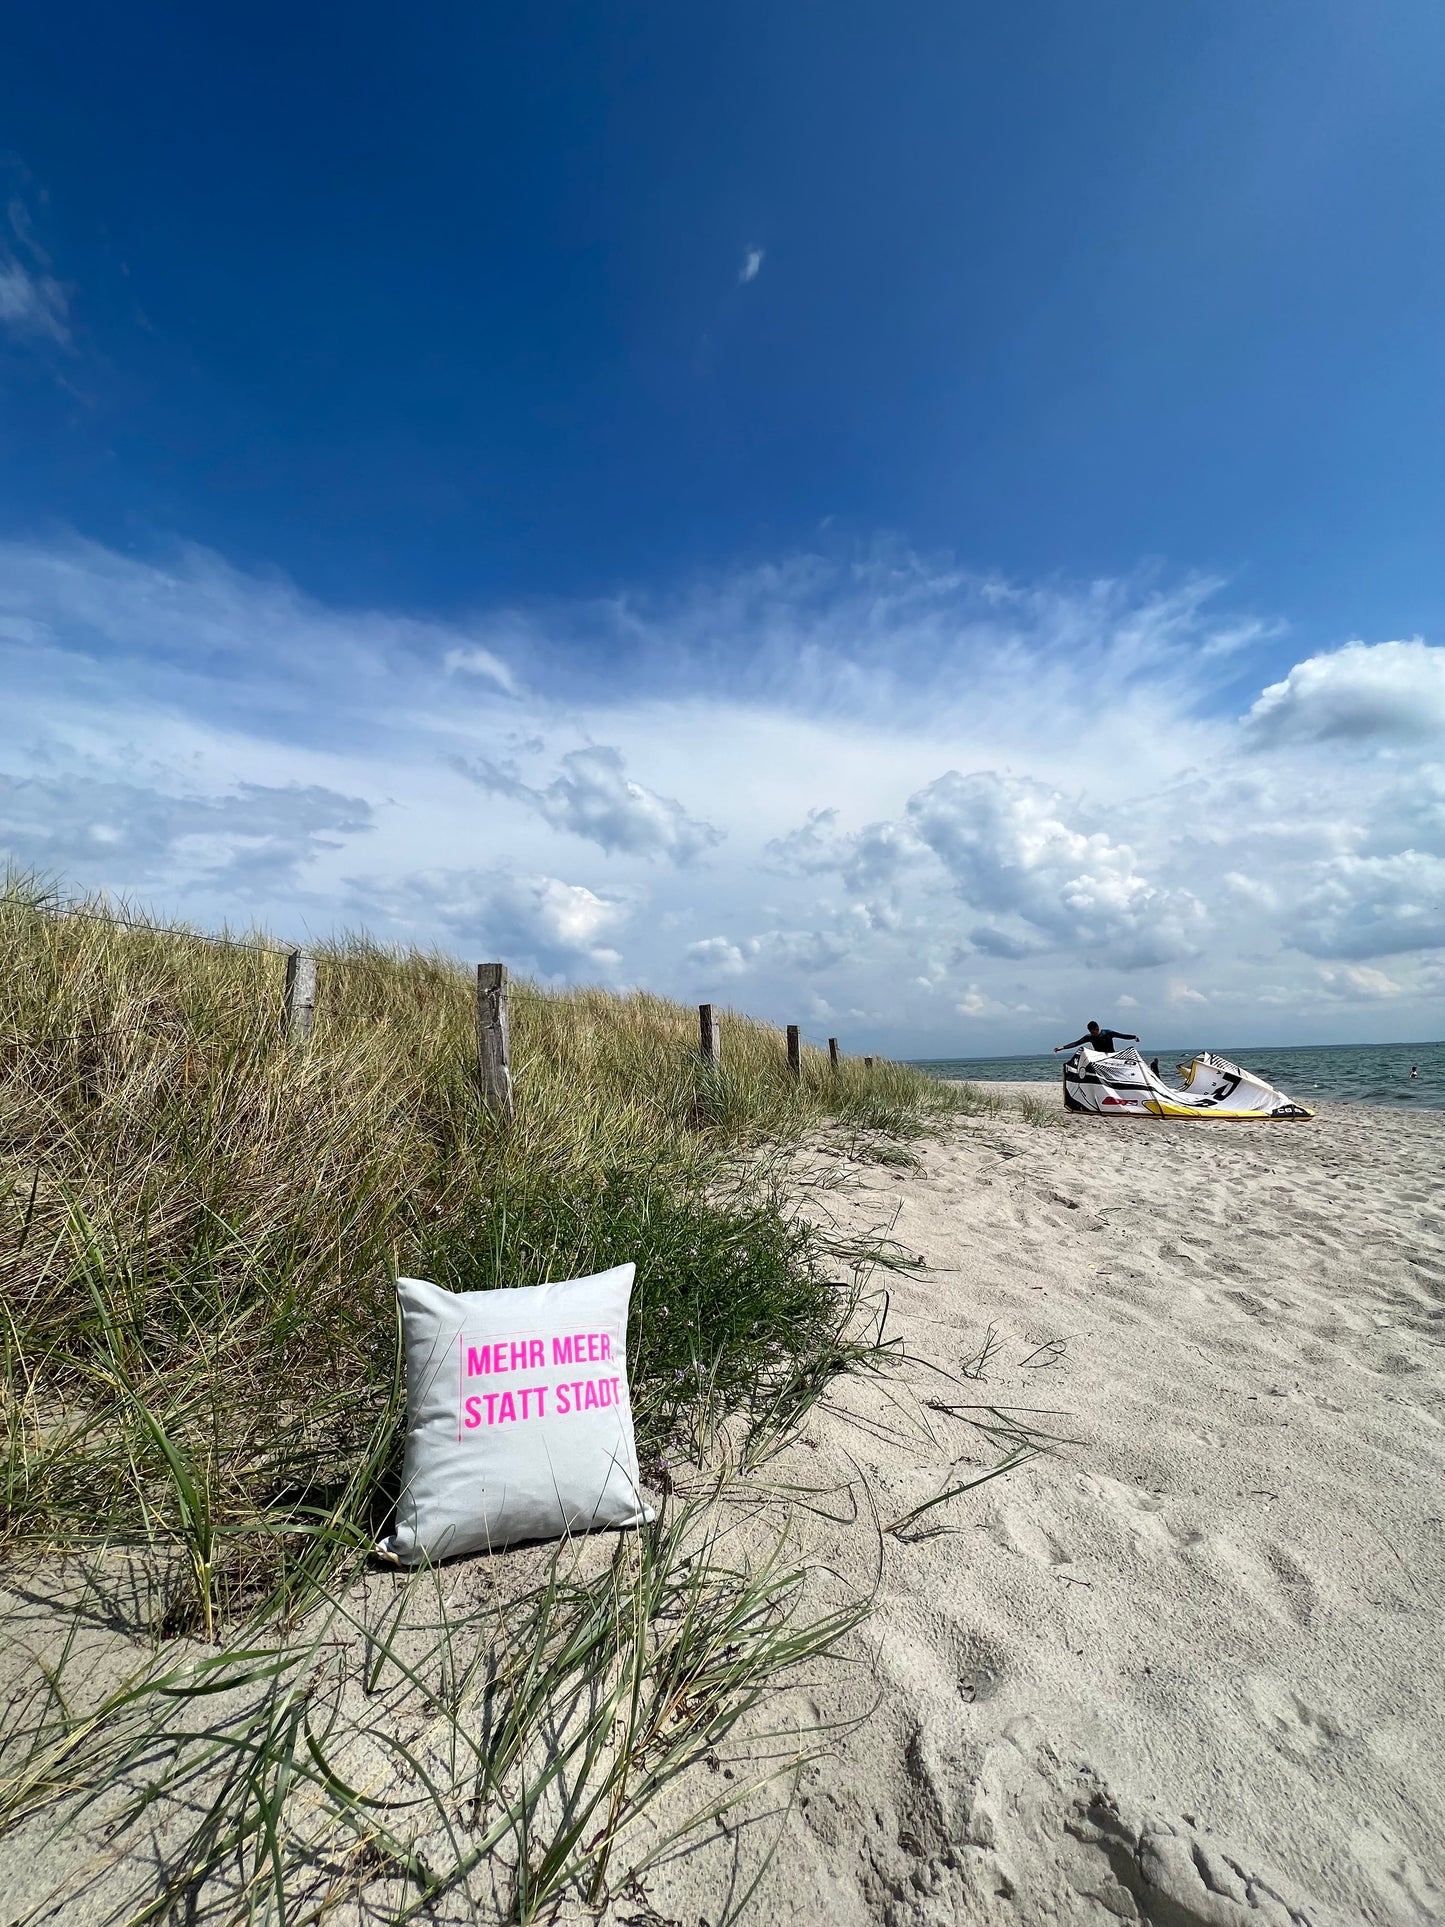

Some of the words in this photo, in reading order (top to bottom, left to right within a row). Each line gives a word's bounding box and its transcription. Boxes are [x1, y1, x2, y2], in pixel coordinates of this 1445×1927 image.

[467, 1340, 545, 1377] MEHR
[464, 1386, 548, 1429] STATT
[556, 1378, 619, 1414] STADT
